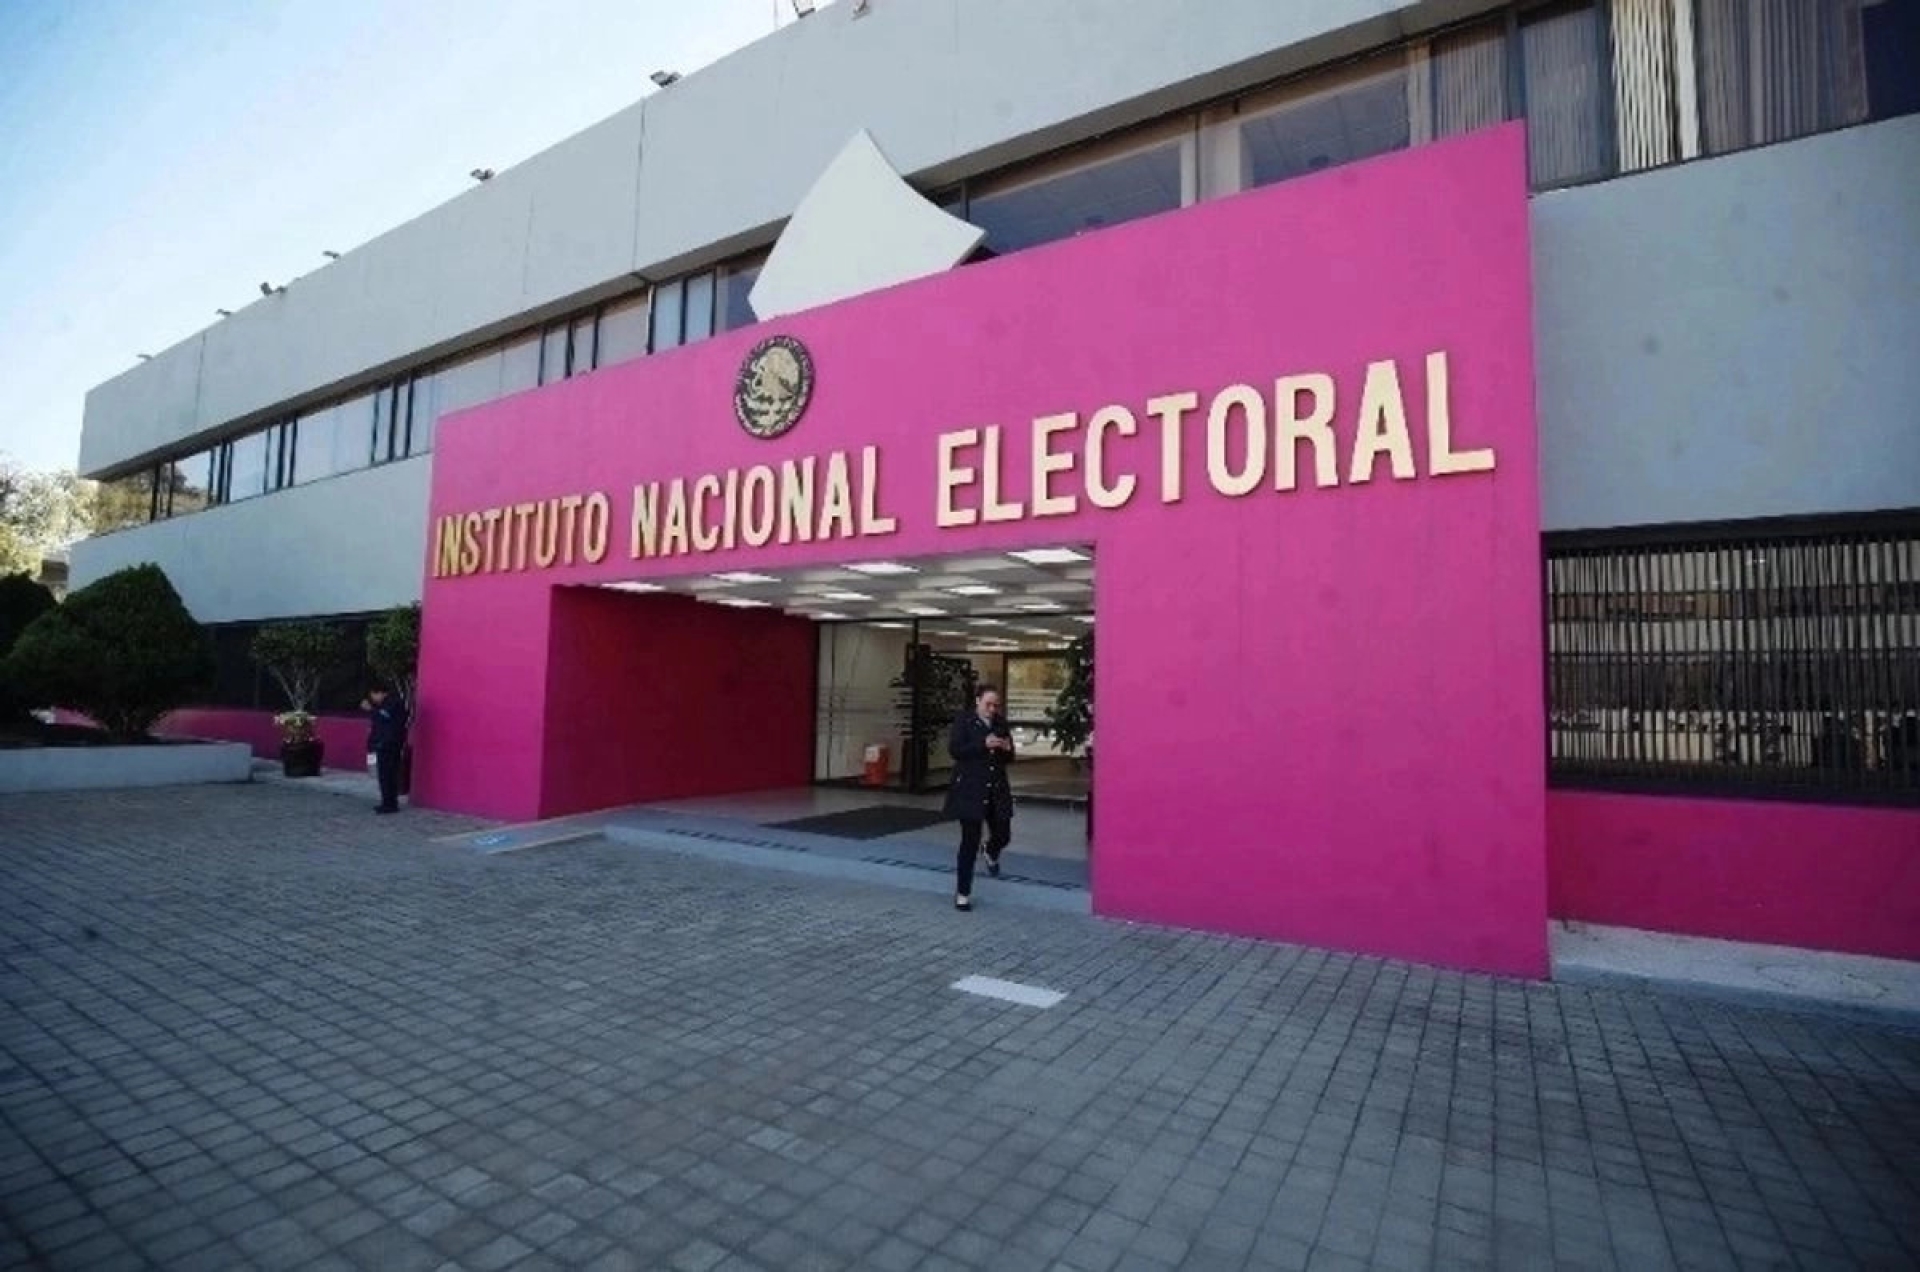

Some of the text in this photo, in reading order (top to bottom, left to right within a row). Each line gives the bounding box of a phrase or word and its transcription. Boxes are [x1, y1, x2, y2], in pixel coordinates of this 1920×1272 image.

[433, 491, 609, 578] INSTITUTO
[630, 446, 896, 559] NACIONAL
[937, 351, 1495, 527] ELECTORAL
